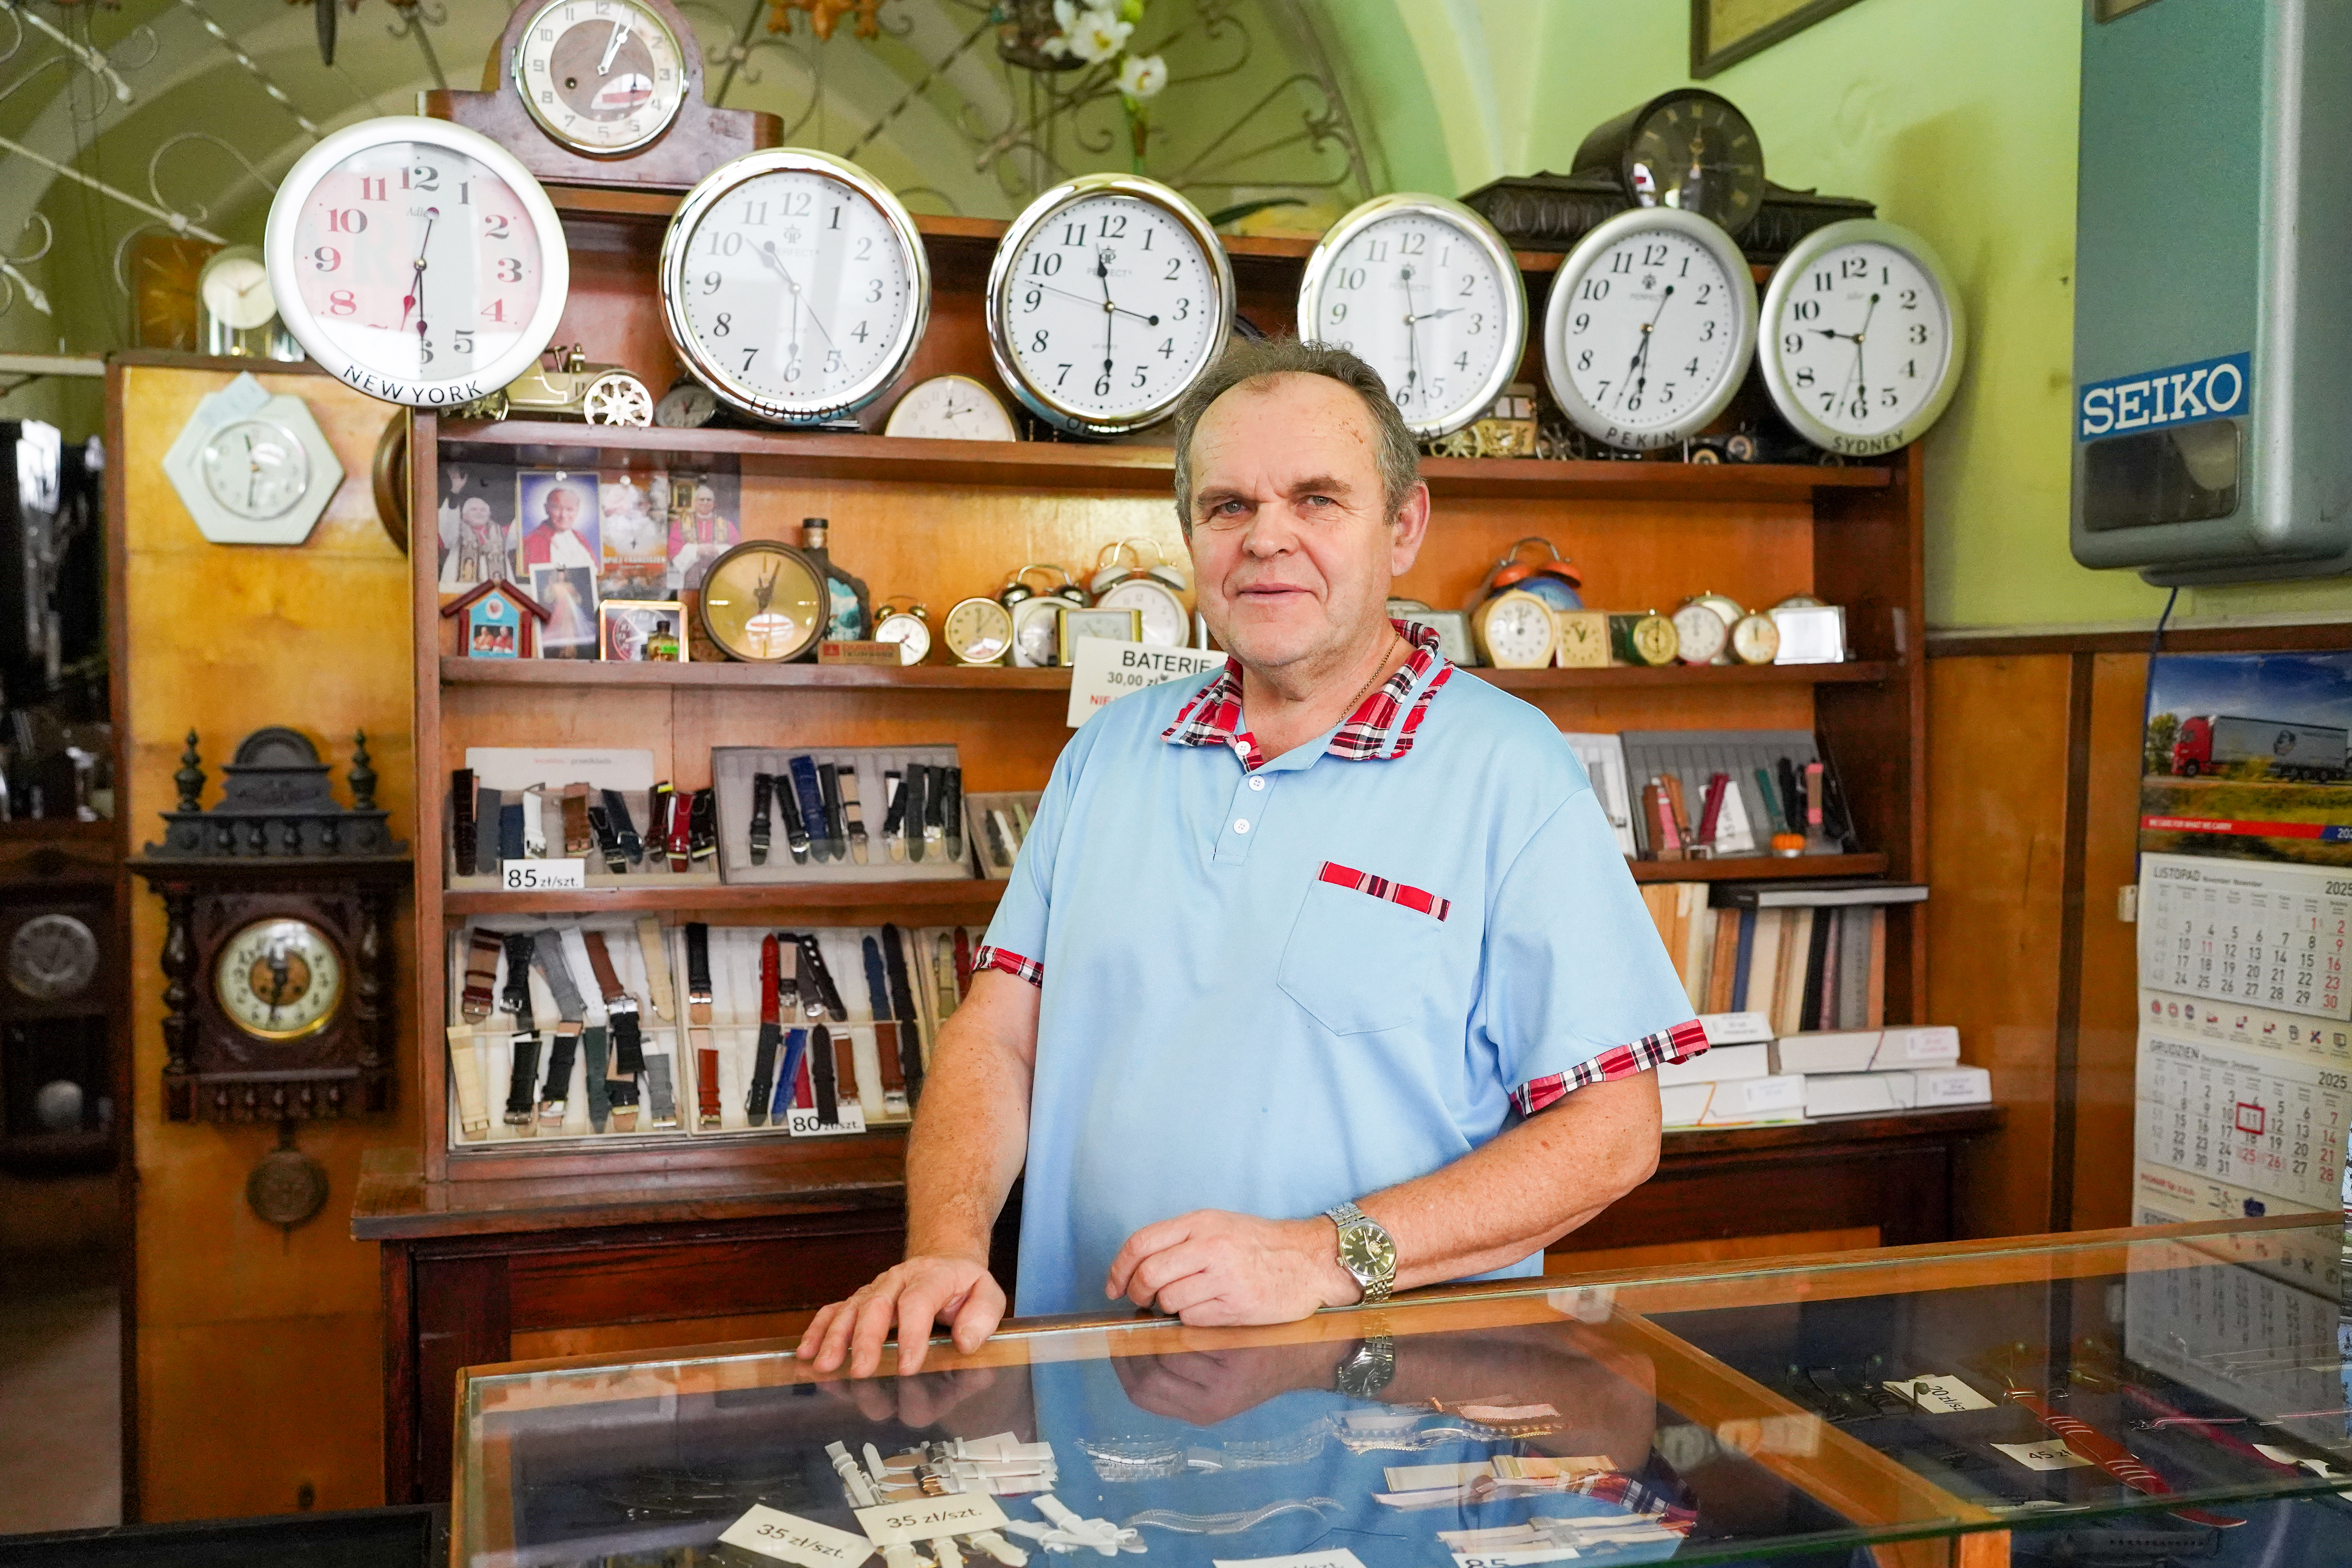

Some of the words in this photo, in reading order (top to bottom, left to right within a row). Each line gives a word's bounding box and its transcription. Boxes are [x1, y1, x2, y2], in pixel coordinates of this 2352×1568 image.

[360, 177, 389, 202] 11
[399, 166, 439, 191] 12
[458, 182, 471, 205] 1
[778, 191, 812, 216] 12
[327, 209, 368, 233] 10
[740, 201, 768, 226] 11
[828, 206, 841, 230] 1
[485, 215, 509, 239] 2
[1061, 223, 1087, 247] 11
[1096, 215, 1127, 238] 12
[706, 232, 743, 256] 10
[855, 238, 872, 261] 2
[1141, 228, 1153, 251] 1
[1398, 233, 1425, 254] 12
[315, 247, 341, 271] 9
[1364, 240, 1388, 262] 11
[1438, 246, 1450, 267] 1
[1642, 245, 1667, 266] 12
[498, 258, 522, 282] 3
[1029, 253, 1062, 276] 10
[1164, 258, 1181, 280] 2
[1611, 252, 1633, 273] 11
[1679, 257, 1690, 277] 1
[1840, 257, 1868, 279] 12
[703, 271, 722, 295] 9
[1336, 267, 1366, 290] 10
[1459, 274, 1475, 296] 2
[1815, 272, 1833, 292] 11
[1881, 267, 1890, 285] 1
[866, 279, 883, 303] 3
[1581, 279, 1609, 300] 10
[1695, 285, 1710, 305] 2
[1900, 290, 1917, 310] 2
[330, 290, 357, 315] 8
[481, 299, 507, 322] 4
[1024, 290, 1042, 313] 9
[1173, 298, 1190, 321] 3
[1793, 299, 1820, 321] 10
[1330, 303, 1347, 324] 9
[1467, 313, 1482, 334] 3
[1573, 313, 1590, 334] 9
[714, 313, 731, 337] 8
[851, 321, 869, 343] 4
[1700, 320, 1715, 342] 3
[1910, 324, 1927, 344] 3
[454, 330, 475, 354] 5
[1032, 329, 1049, 352] 8
[1158, 338, 1174, 359] 4
[1785, 334, 1802, 353] 9
[742, 348, 759, 372] 7
[784, 358, 801, 383] 6
[824, 350, 841, 373] 5
[1454, 351, 1469, 371] 4
[1578, 349, 1593, 371] 8
[1685, 357, 1698, 376] 4
[1900, 359, 1915, 377] 4
[344, 364, 403, 400] NEW
[412, 380, 483, 403] YORK
[1056, 364, 1072, 385] 7
[1095, 374, 1110, 396] 6
[1131, 366, 1148, 387] 5
[1796, 366, 1814, 388] 8
[1395, 385, 1410, 406] 6
[1429, 378, 1445, 399] 5
[1596, 380, 1611, 401] 7
[1660, 383, 1676, 403] 5
[1881, 388, 1898, 407] 5
[2083, 364, 2242, 435] SEIKO
[751, 395, 849, 422] LONDON
[1628, 394, 1642, 411] 6
[1820, 392, 1835, 412] 7
[1851, 400, 1869, 419] 6
[1606, 427, 1677, 445] PEKIN
[1833, 430, 1904, 454] SYDNEY
[1122, 651, 1211, 674] BATERIE
[1107, 672, 1143, 686] 30,00
[509, 869, 536, 887] 85
[541, 876, 578, 887] zł/szt.
[2319, 1071, 2348, 1089] 2025
[794, 1116, 820, 1131] 80
[887, 1515, 917, 1528] 35
[922, 1509, 982, 1523] zł/szt.
[757, 1524, 789, 1539] 35
[788, 1536, 844, 1558] zł/szt.
